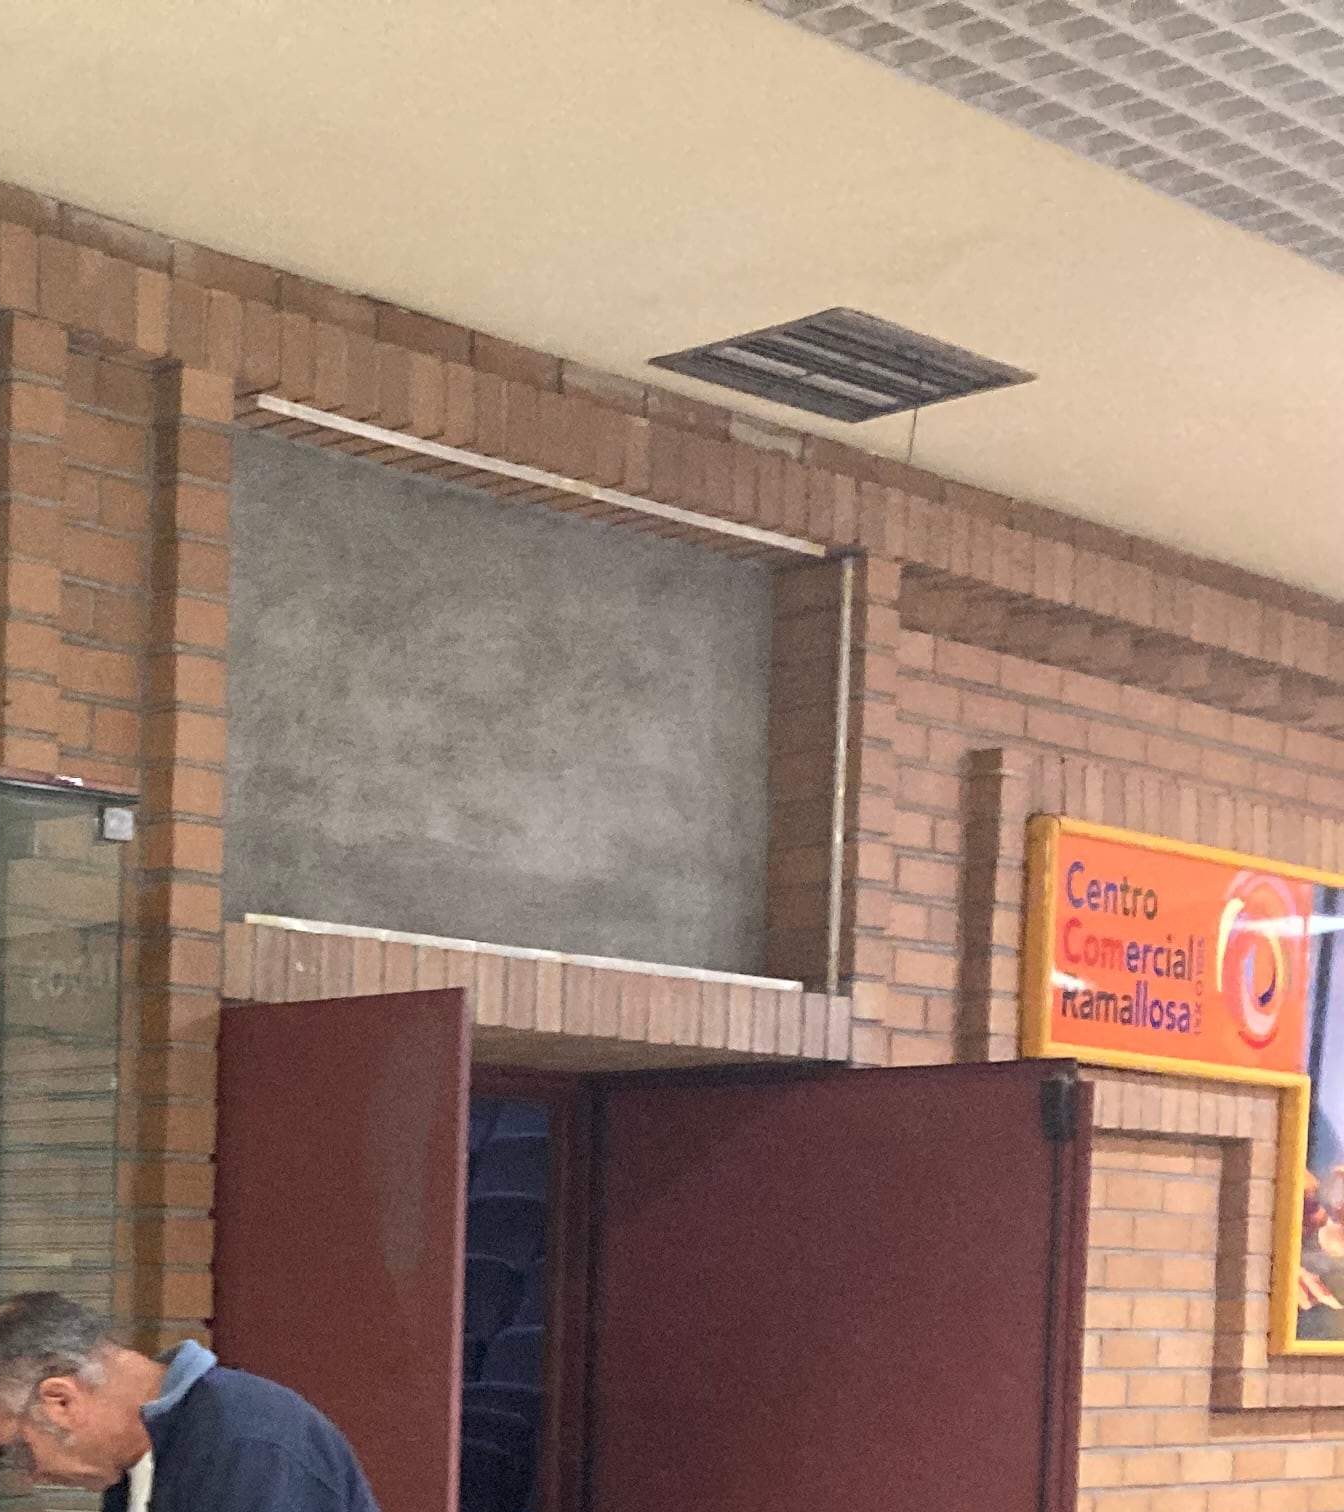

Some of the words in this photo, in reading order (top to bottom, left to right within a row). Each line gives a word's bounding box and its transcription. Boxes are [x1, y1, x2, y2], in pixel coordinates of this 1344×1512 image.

[1066, 861, 1158, 920] Centro
[1063, 917, 1195, 981] Comercial
[1062, 972, 1192, 1033] Ramallosa
